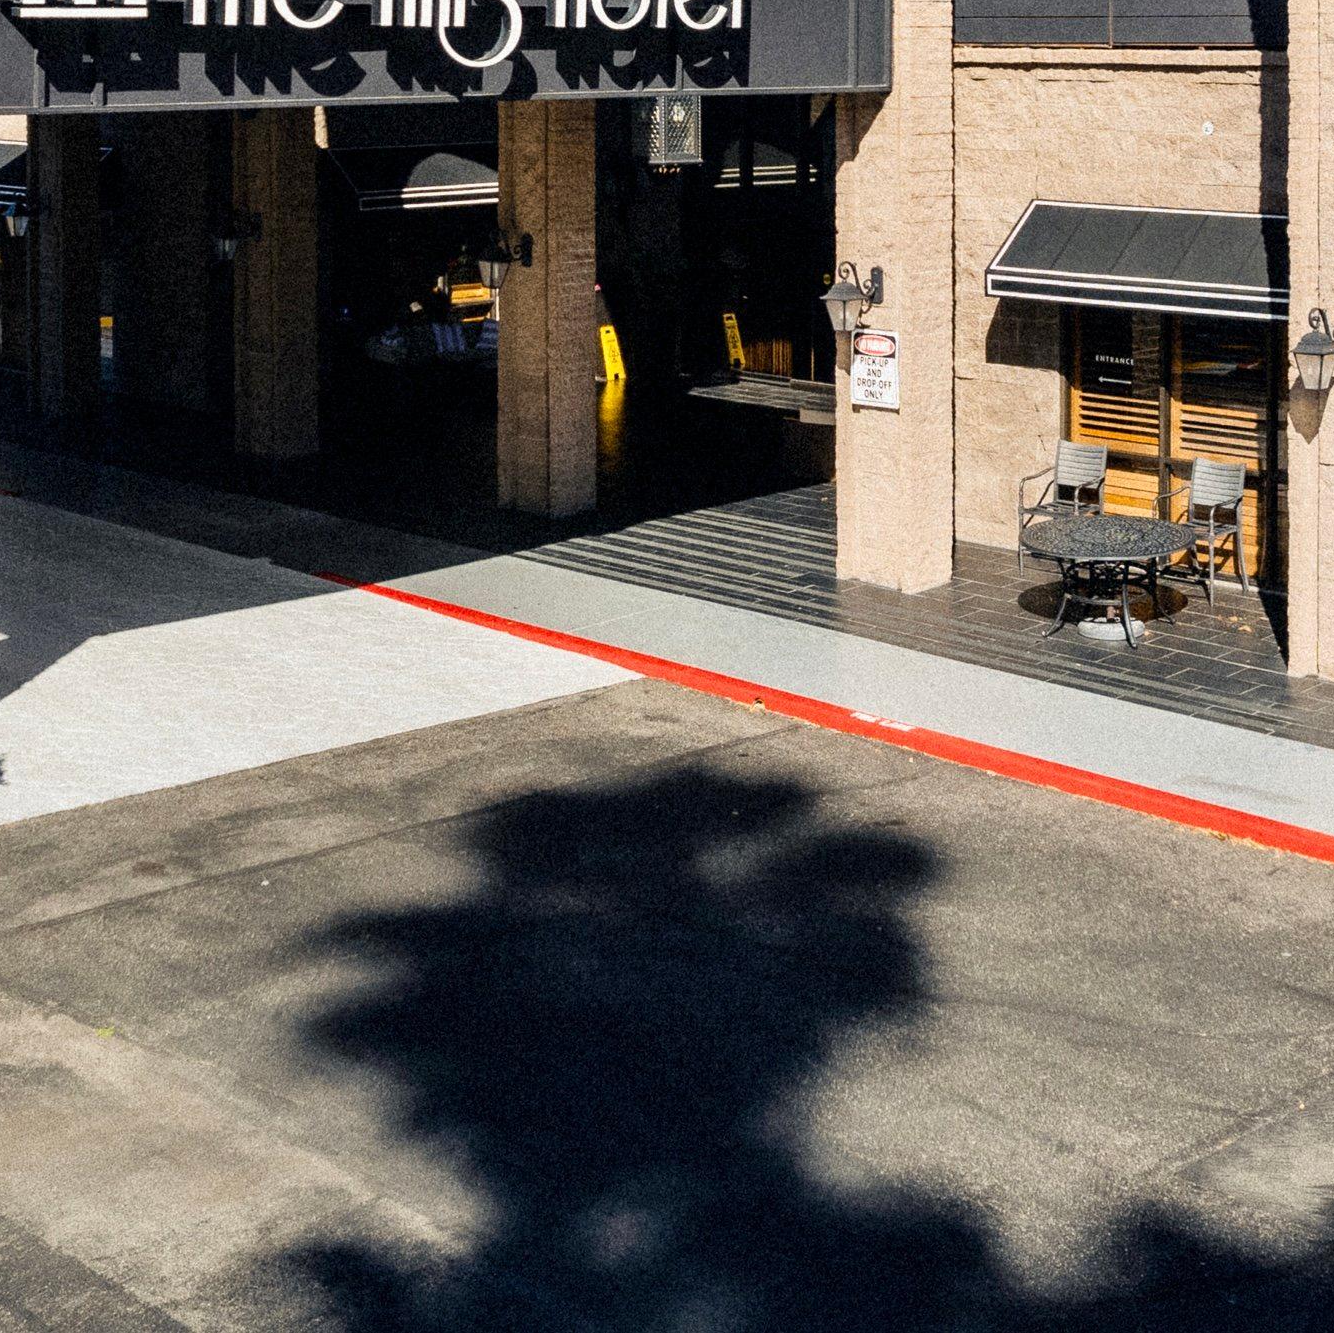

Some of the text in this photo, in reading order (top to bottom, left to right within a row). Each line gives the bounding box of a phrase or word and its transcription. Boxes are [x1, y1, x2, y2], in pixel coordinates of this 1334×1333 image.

[1095, 354, 1135, 366] ENTRANCE
[866, 368, 882, 378] AND
[864, 389, 884, 400] ONLY
